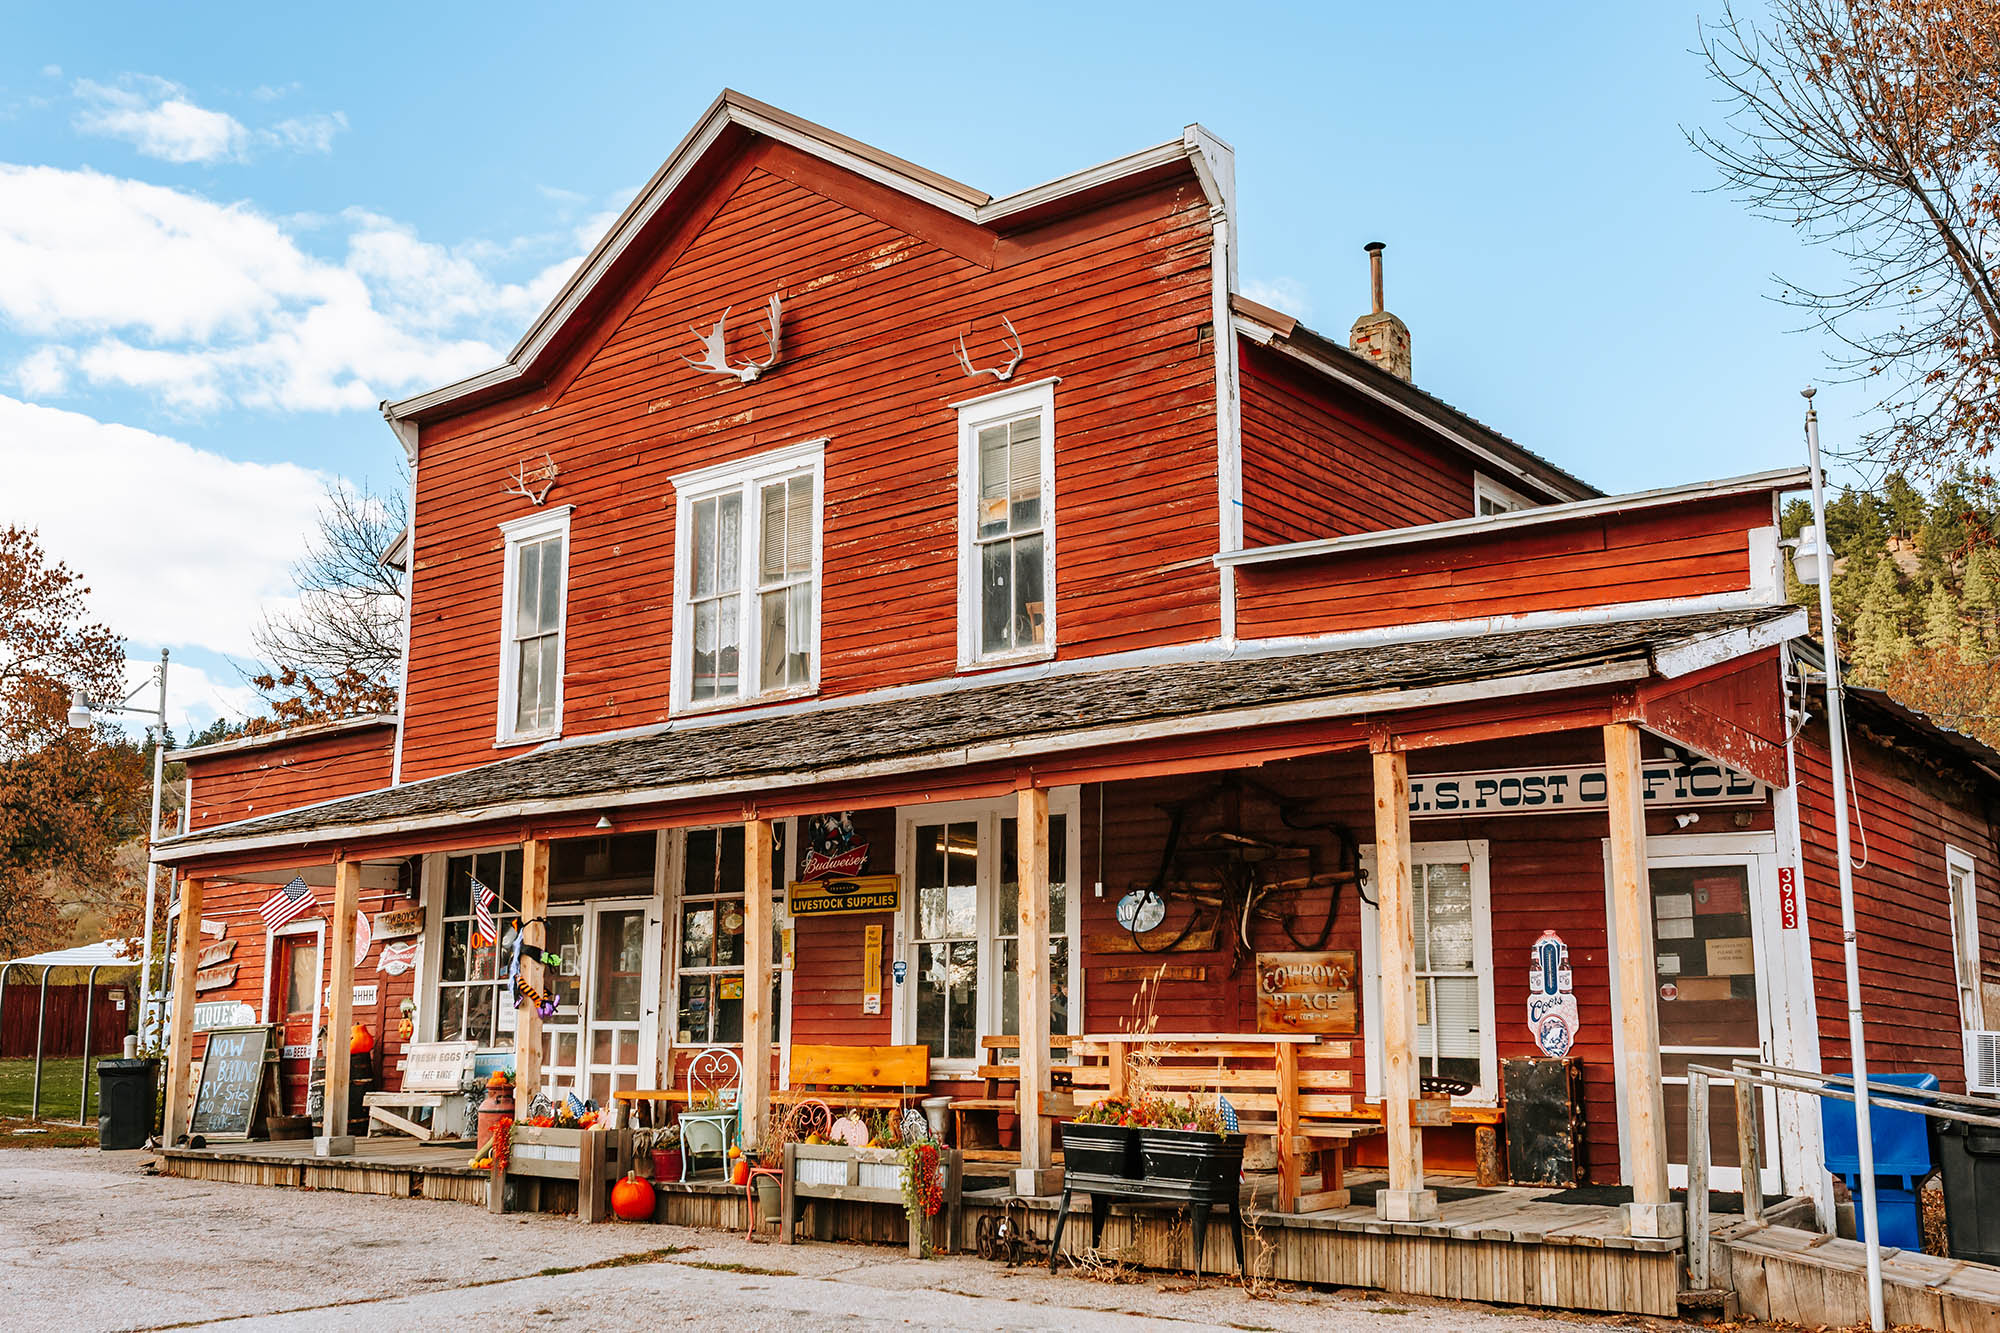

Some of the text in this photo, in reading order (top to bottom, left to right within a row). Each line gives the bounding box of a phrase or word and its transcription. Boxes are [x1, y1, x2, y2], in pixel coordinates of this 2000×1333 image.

[1475, 776, 1569, 808] POST
[1579, 765, 1756, 802] OFICE
[801, 849, 868, 874] Budweiser
[793, 895, 894, 911] LIVESTOCK SUPPLIES
[1781, 868, 1797, 929] 3983
[1262, 963, 1350, 993] COWBOY'S
[1272, 993, 1339, 1010] PLACE
[1530, 996, 1563, 1023] Coors
[194, 1003, 241, 1025] TIQUES
[210, 1036, 247, 1056] NOW
[294, 1047, 307, 1057] BEER
[411, 1053, 461, 1063] FRESH EGGS
